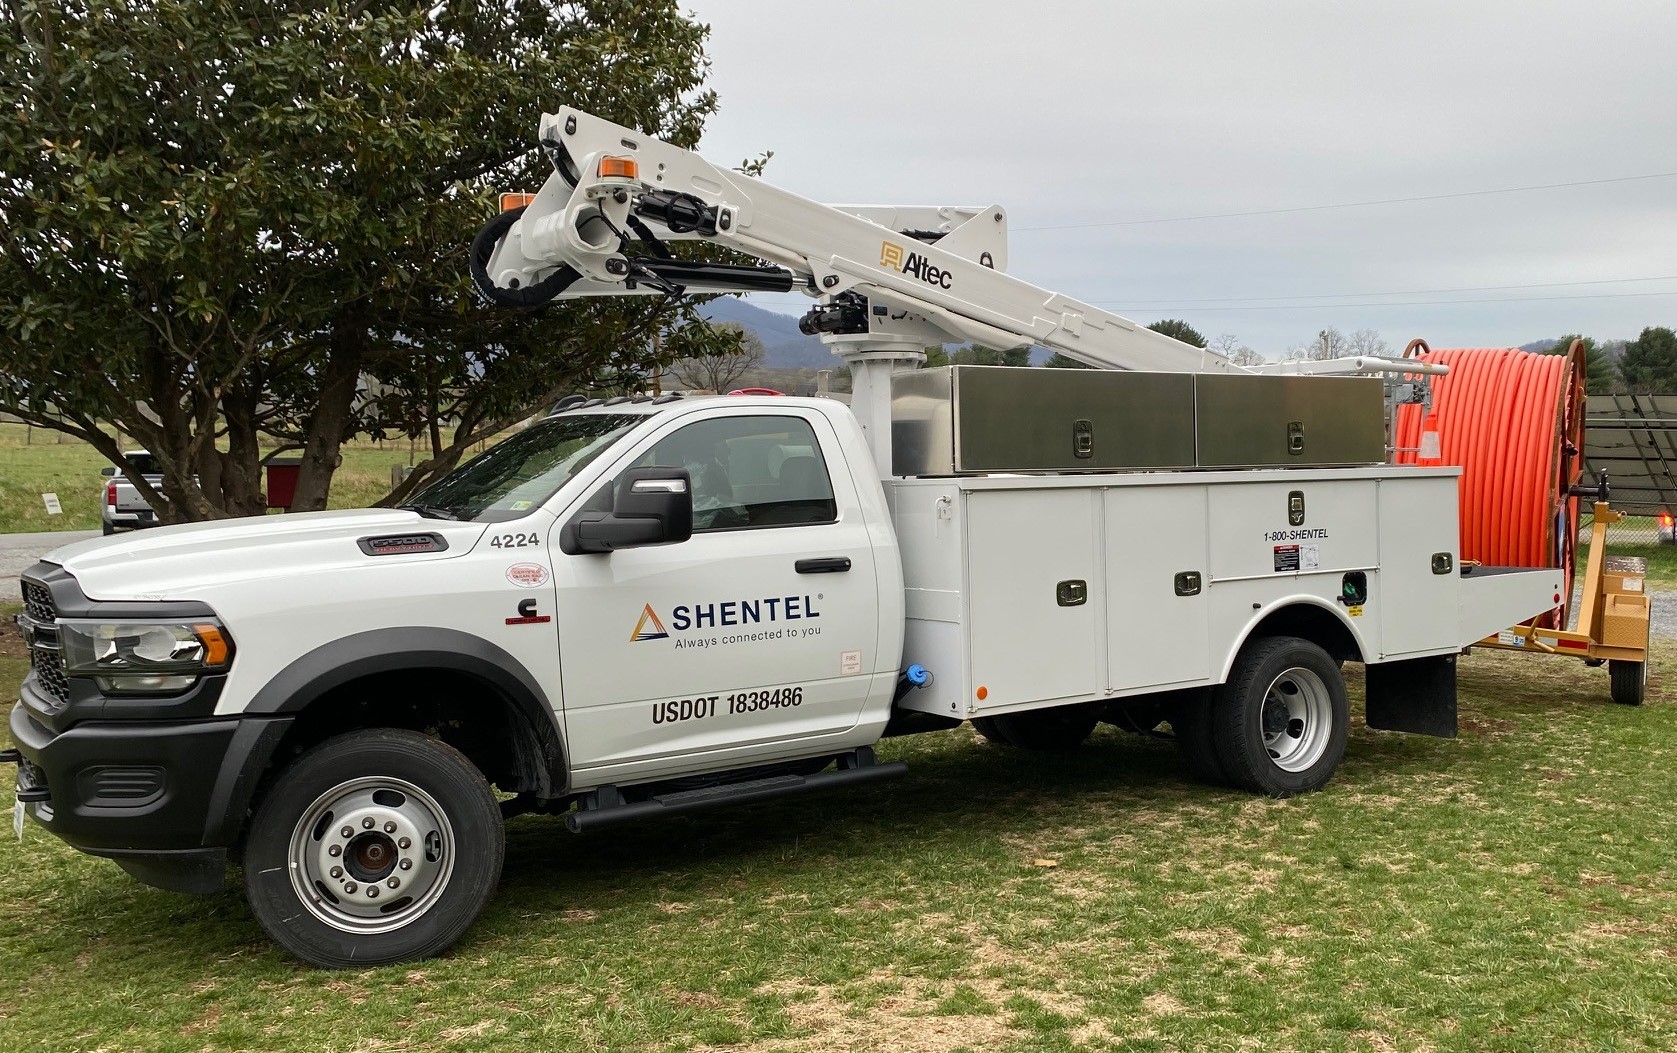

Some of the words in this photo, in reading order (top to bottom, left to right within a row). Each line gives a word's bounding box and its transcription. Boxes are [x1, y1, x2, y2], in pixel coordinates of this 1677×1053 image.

[902, 252, 952, 289] Altec
[373, 536, 432, 548] 5500
[490, 533, 540, 549] 4224
[1264, 529, 1329, 541] 1-800-SHENTEL
[672, 595, 820, 631] SHENTEL
[674, 637, 717, 649] Always
[722, 629, 782, 645] connected
[786, 628, 798, 638] to
[801, 627, 821, 639] you
[652, 696, 719, 725] USDOT
[726, 686, 803, 714] 1838486
